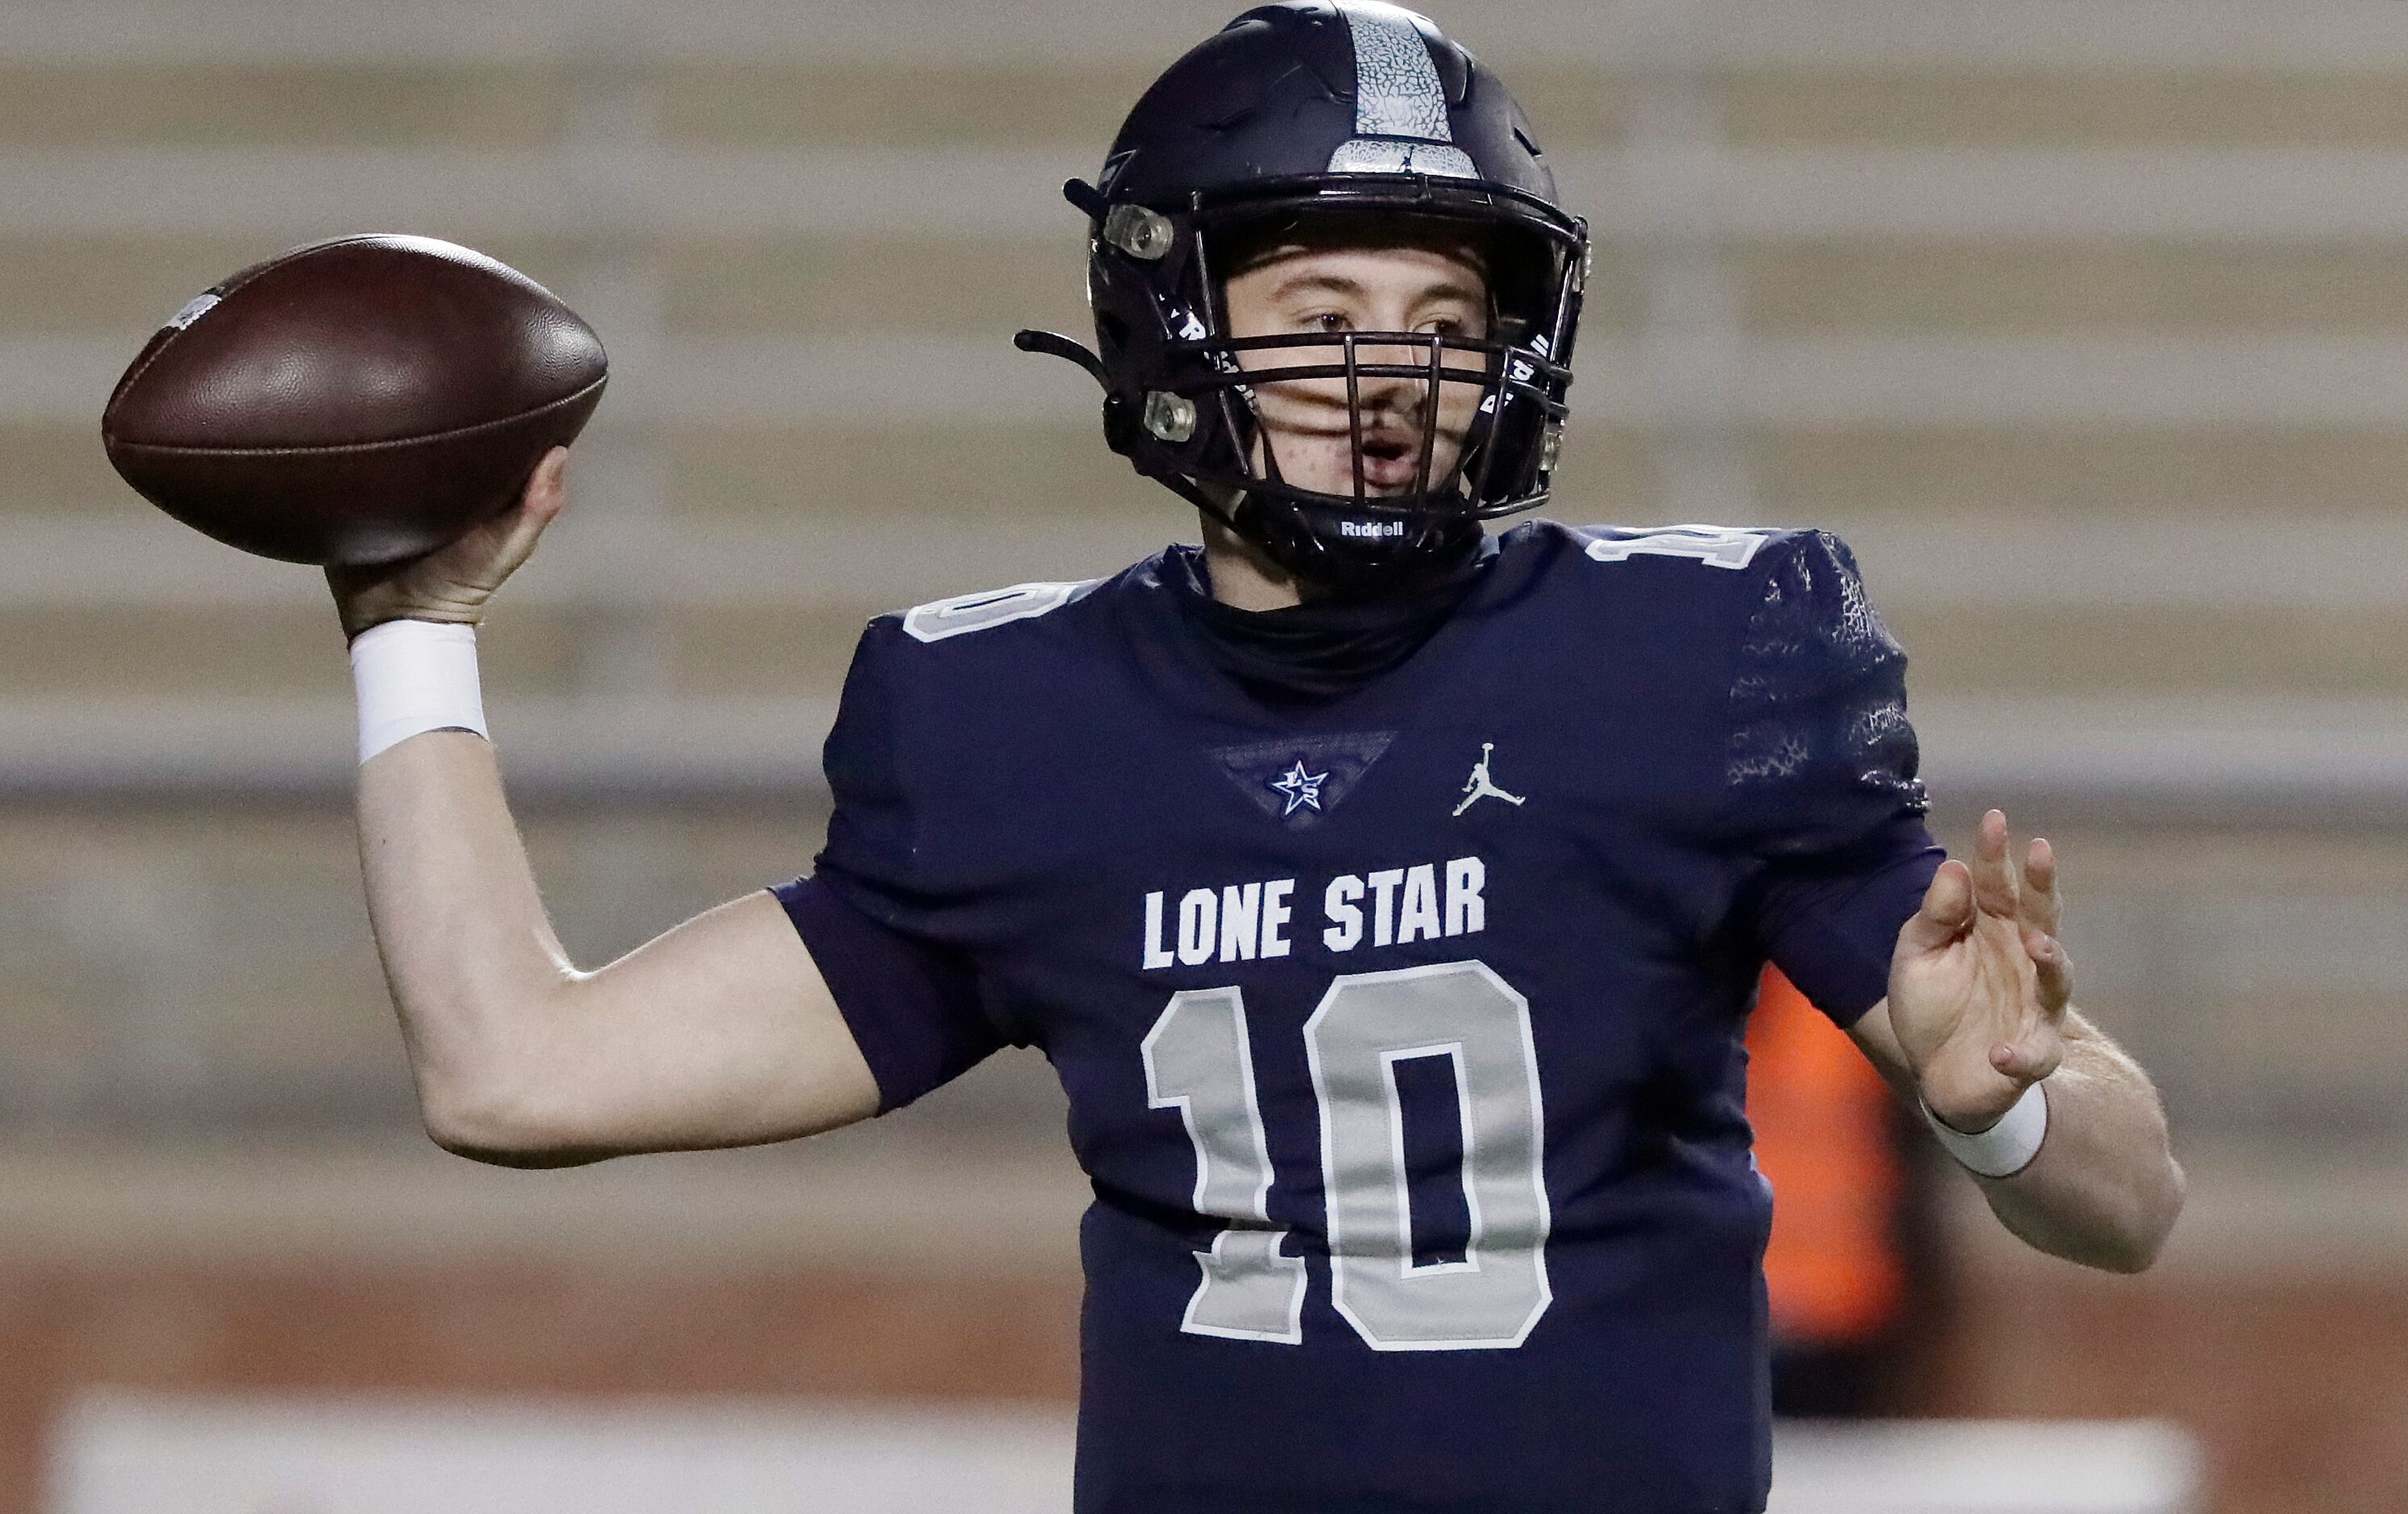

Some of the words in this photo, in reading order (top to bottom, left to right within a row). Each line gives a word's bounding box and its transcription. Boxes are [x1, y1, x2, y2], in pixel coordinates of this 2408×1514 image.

[1341, 521, 1403, 537] Riddell
[1143, 878, 1295, 970] LONE
[1323, 856, 1485, 953] STAR
[1140, 959, 1553, 1351] 10
